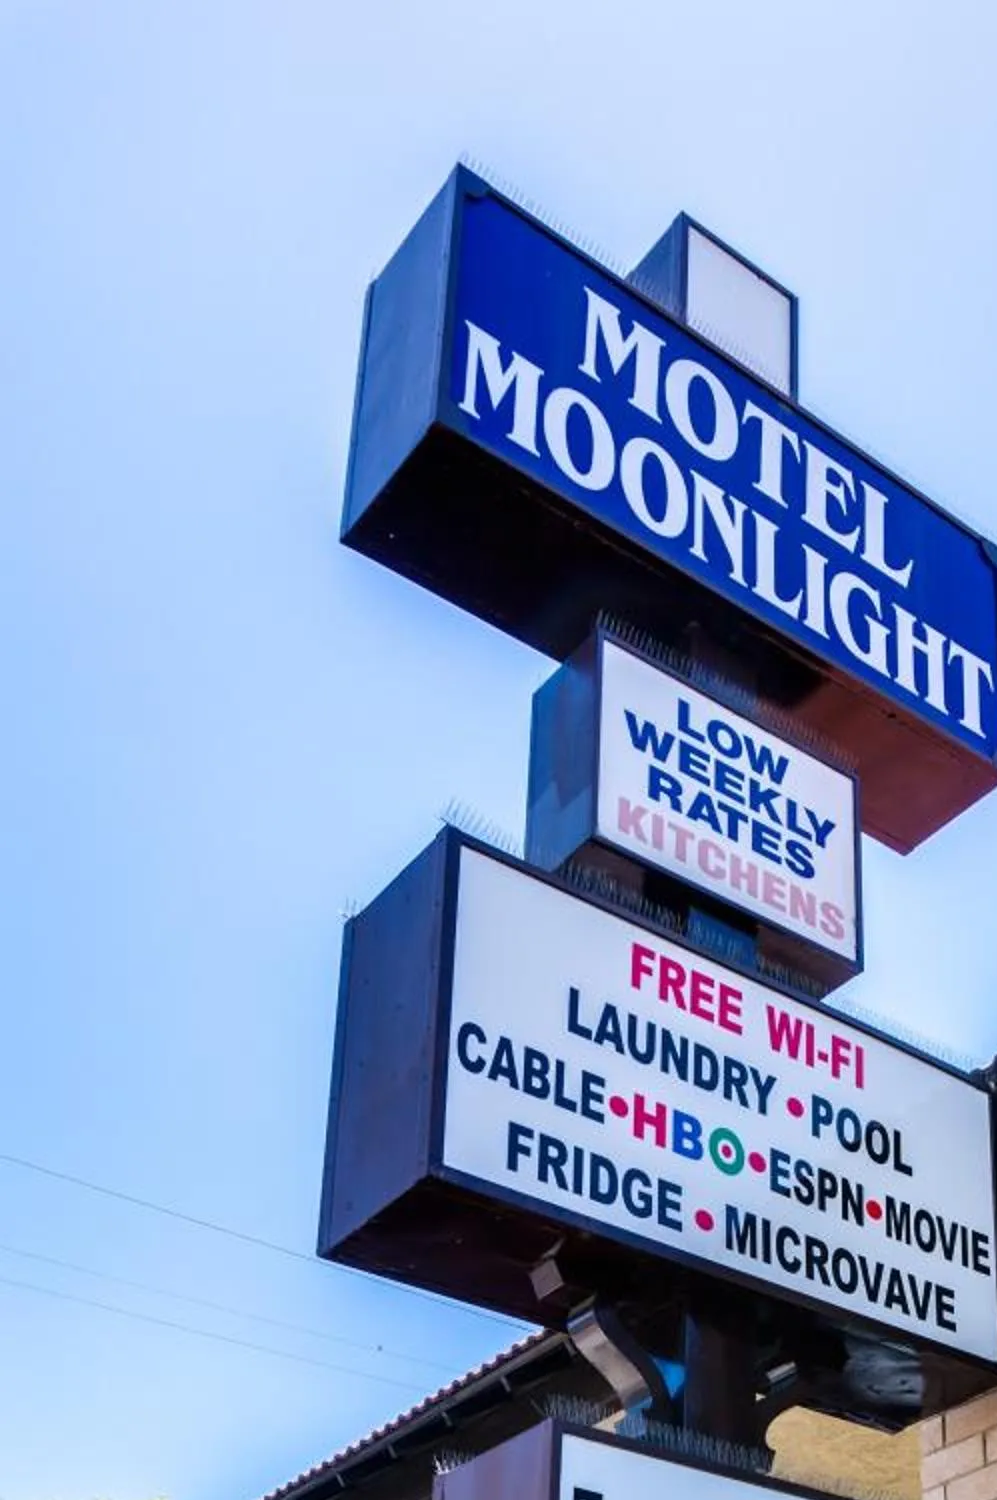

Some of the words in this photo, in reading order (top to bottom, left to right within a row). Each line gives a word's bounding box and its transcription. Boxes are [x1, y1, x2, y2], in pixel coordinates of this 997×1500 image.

[578, 286, 914, 589] MOTEL
[458, 319, 995, 739] MOONLIGHT
[624, 708, 836, 849] WEEKLY
[648, 764, 815, 879] RATES
[678, 697, 789, 785] LOW
[617, 796, 845, 940] KITCHENS
[567, 986, 777, 1115] LAUNDRY
[811, 1094, 913, 1177] POOL
[631, 942, 742, 1036] FREE
[766, 1003, 864, 1089] WI-FI
[457, 1022, 605, 1124] CABLE
[633, 1093, 745, 1176] HBO
[770, 1148, 864, 1227] ESPN
[885, 1195, 991, 1276] MOVIE
[507, 1121, 683, 1232] FRIDGE
[725, 1204, 957, 1332] MICROVAVE
